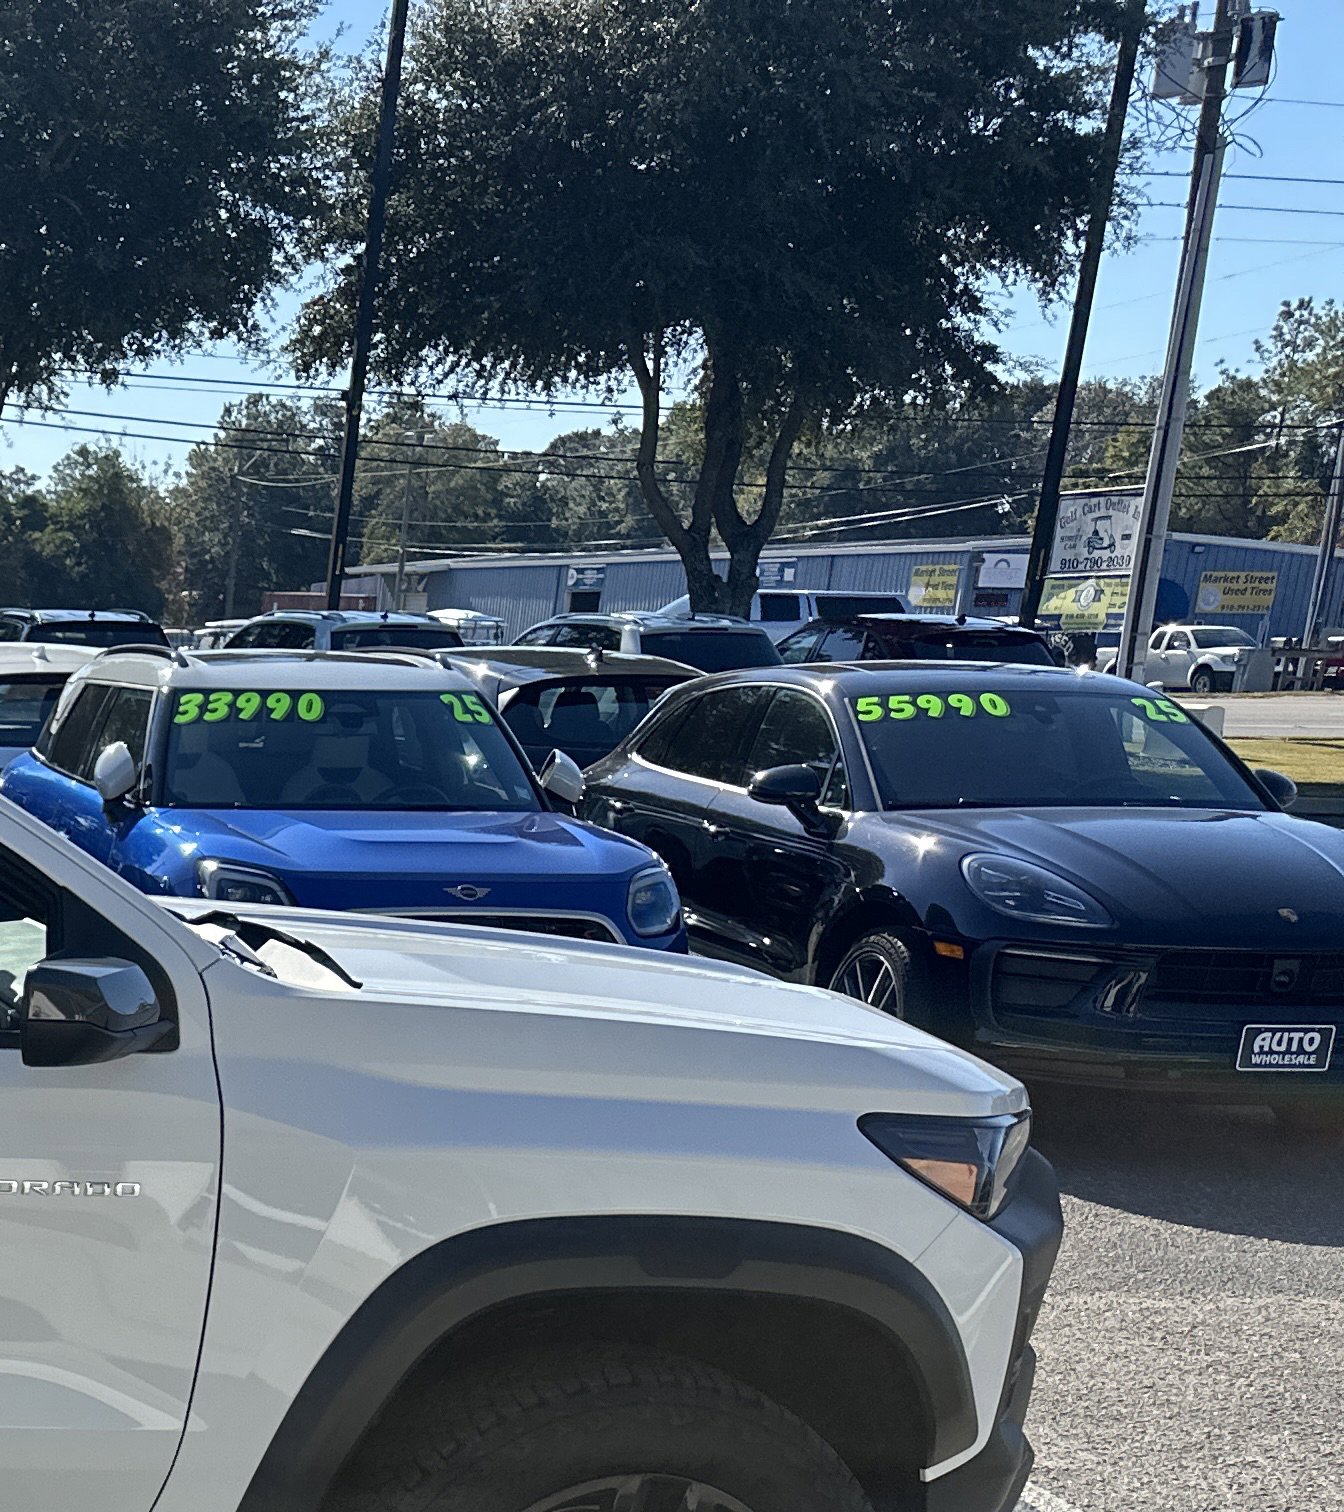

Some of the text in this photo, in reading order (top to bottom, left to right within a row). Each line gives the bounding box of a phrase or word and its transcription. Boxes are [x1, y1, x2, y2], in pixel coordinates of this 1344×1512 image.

[1059, 555, 1132, 570] 910-790-2030
[1202, 573, 1276, 584] Market Street
[1222, 586, 1273, 596] Used Tires
[173, 692, 324, 724] 33990
[439, 693, 492, 725] 25
[856, 692, 1011, 722] 55990
[1131, 697, 1190, 724] 25
[1253, 1031, 1321, 1053] AUTO
[1251, 1054, 1317, 1065] WHOLESALE
